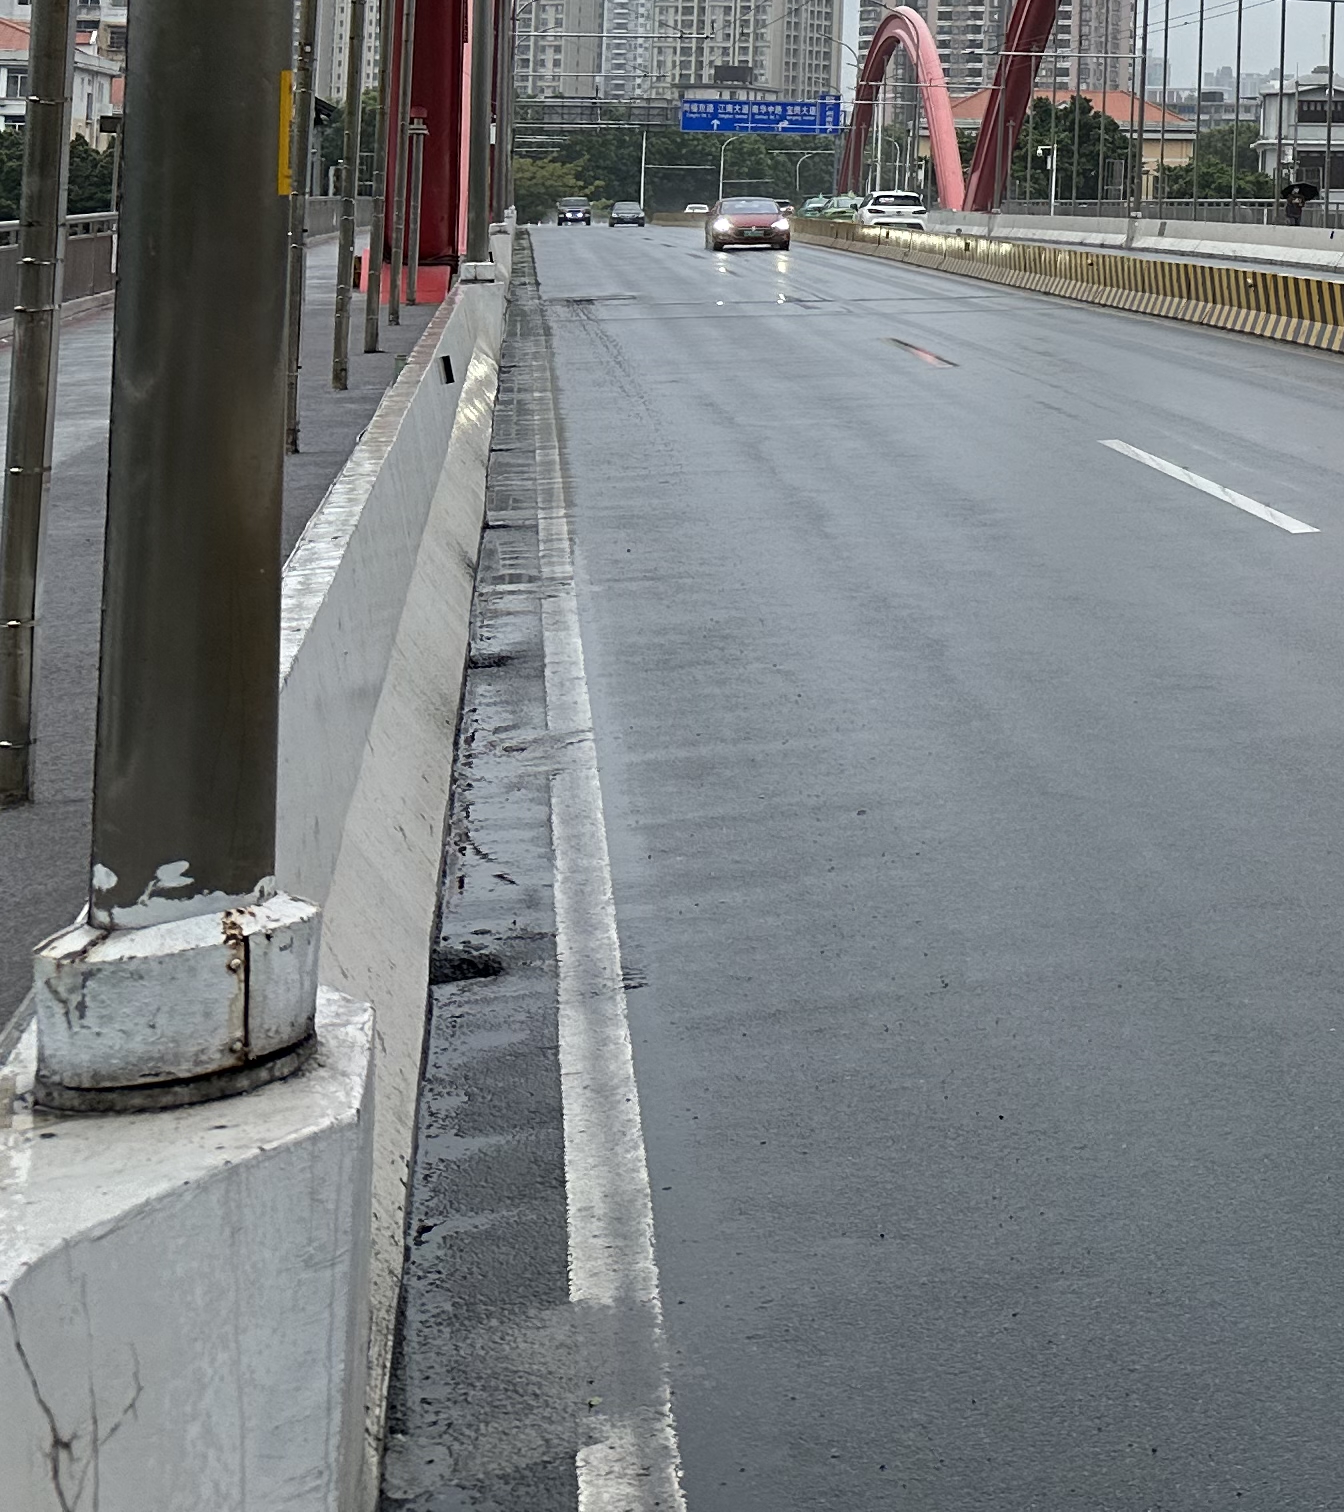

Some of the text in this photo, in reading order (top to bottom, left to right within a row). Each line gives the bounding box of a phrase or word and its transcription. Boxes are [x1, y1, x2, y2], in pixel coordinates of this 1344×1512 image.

[718, 103, 749, 114] 江南大道
[752, 104, 782, 115] 南华中路
